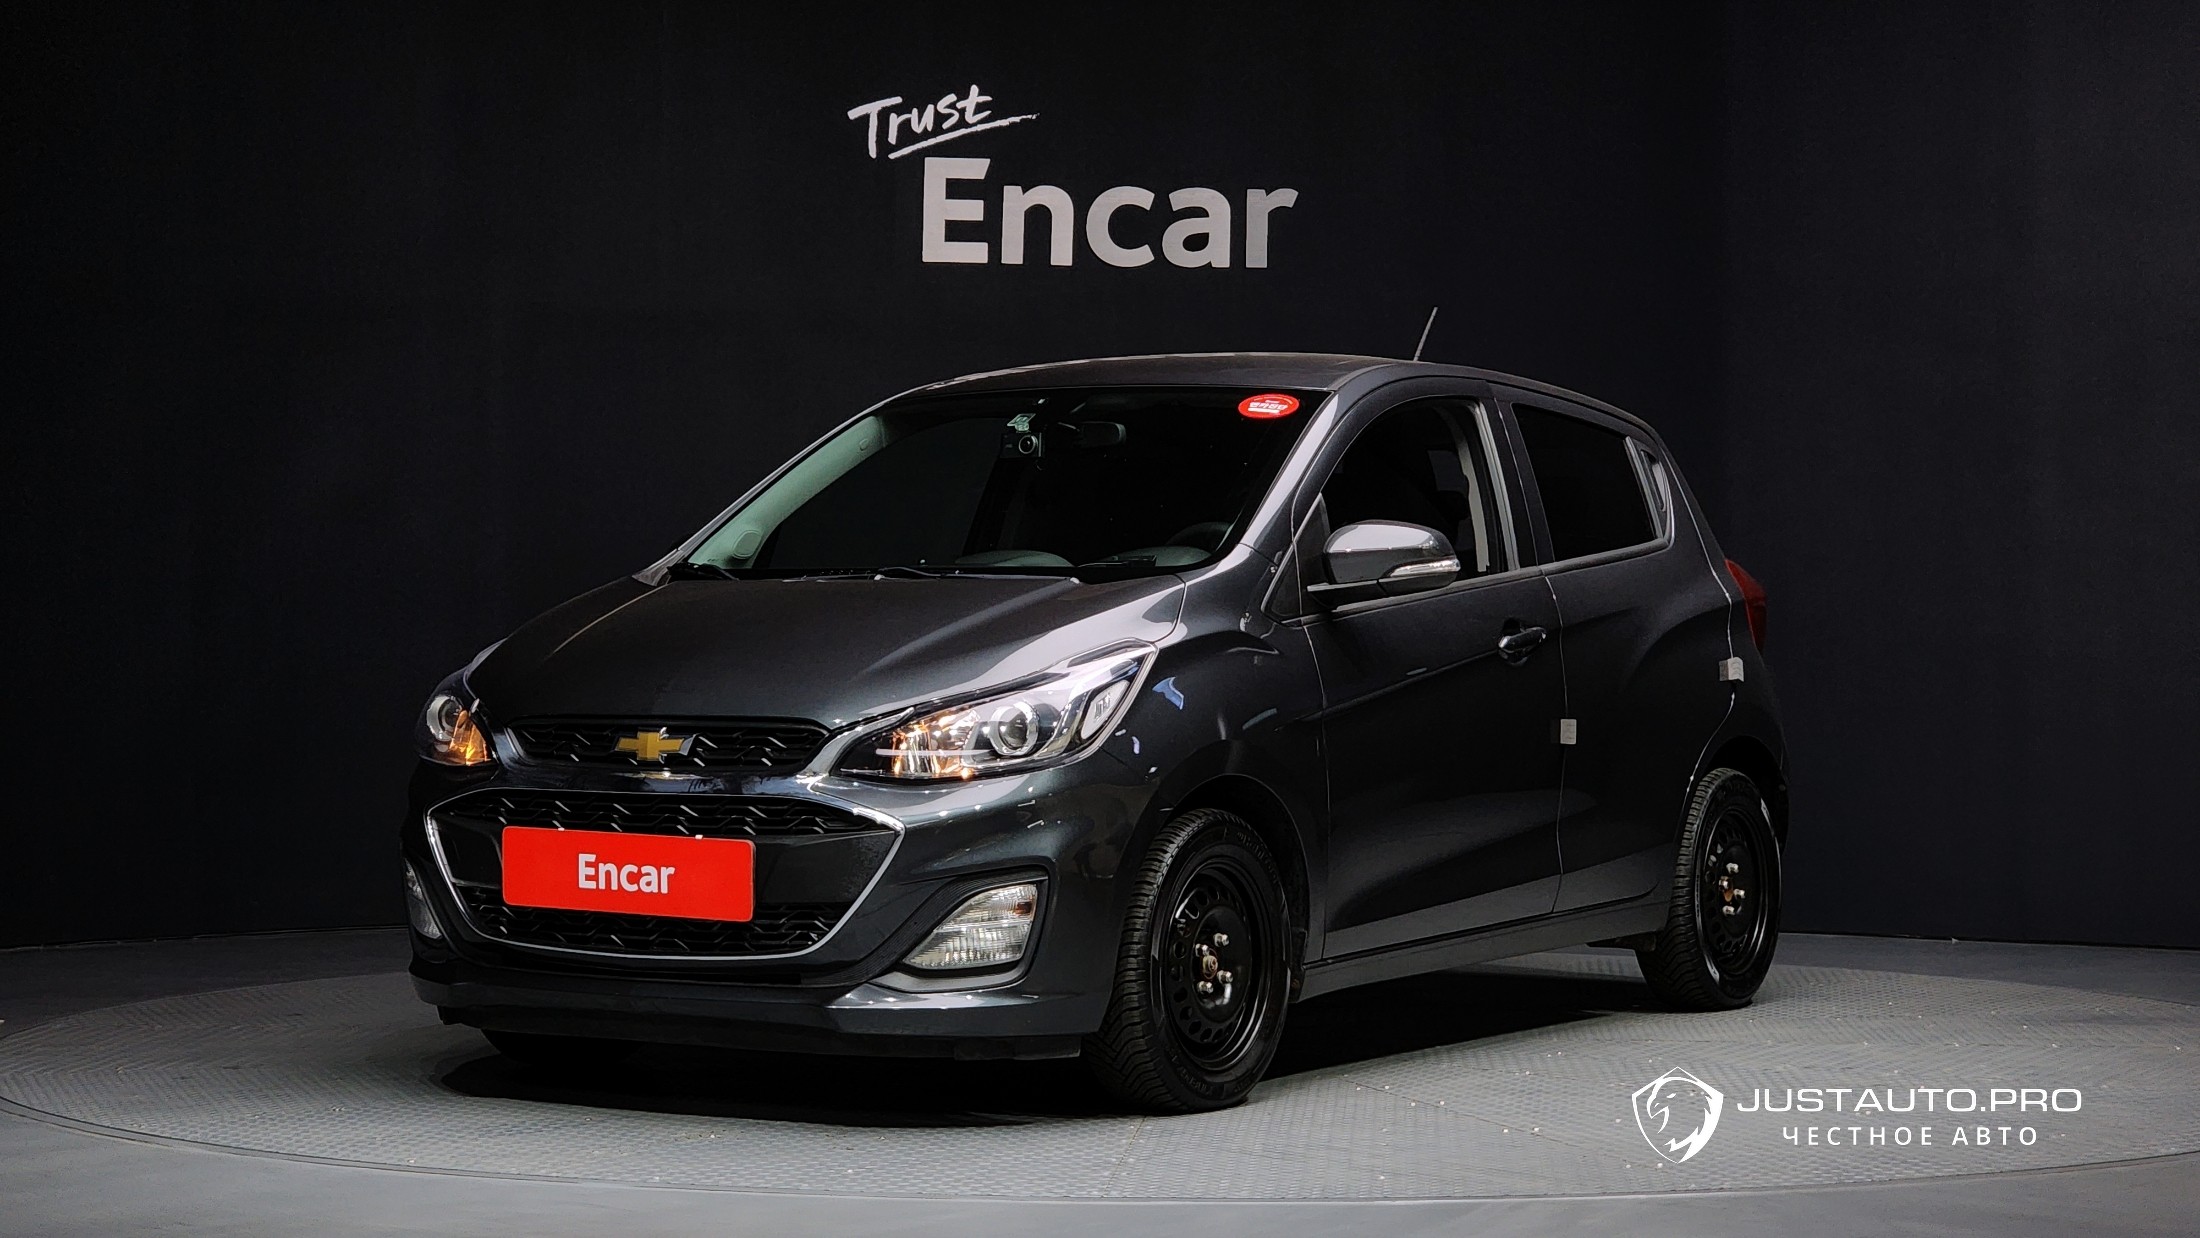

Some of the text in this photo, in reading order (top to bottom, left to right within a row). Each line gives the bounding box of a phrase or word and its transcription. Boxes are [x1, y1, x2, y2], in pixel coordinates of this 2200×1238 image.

[847, 84, 993, 159] Trust
[921, 156, 1298, 268] Encar
[577, 852, 676, 894] Encar
